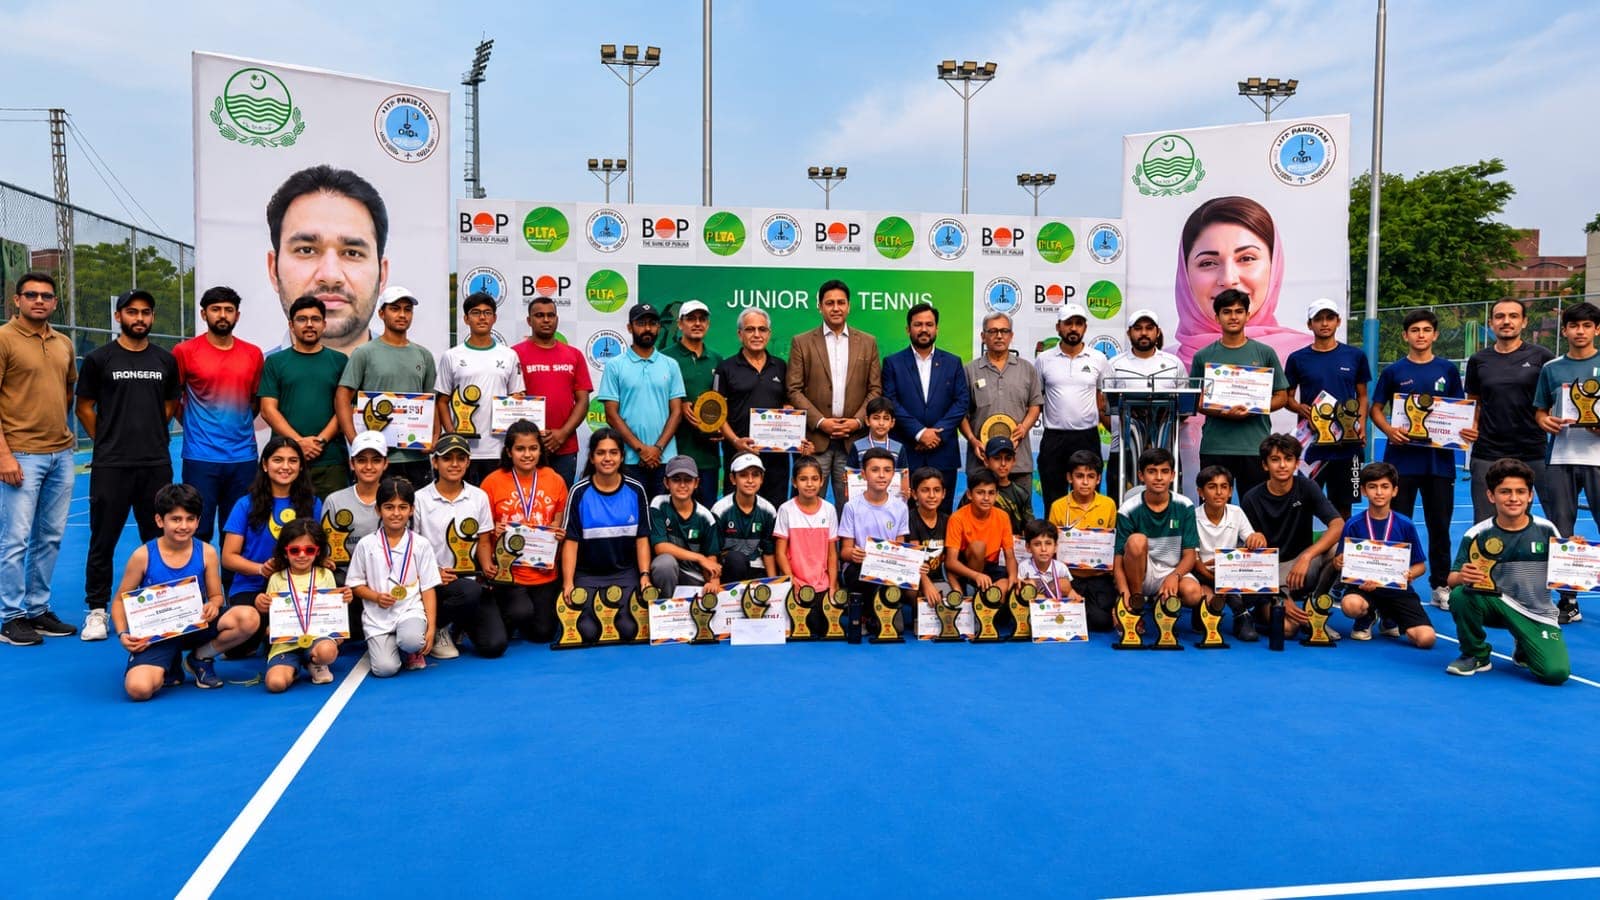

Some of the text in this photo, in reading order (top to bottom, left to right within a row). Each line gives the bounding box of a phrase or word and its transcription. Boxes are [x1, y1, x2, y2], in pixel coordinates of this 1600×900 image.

[460, 212, 509, 234] BOP
[525, 227, 557, 239] PLTA
[642, 217, 689, 239] BOP
[815, 222, 860, 243] BOP
[982, 226, 1024, 248] BOP
[522, 275, 572, 297] BOP
[588, 288, 615, 300] PLTA
[1034, 284, 1075, 305] BOP
[727, 290, 808, 310] JUNIOR
[858, 292, 933, 310] TENNIS
